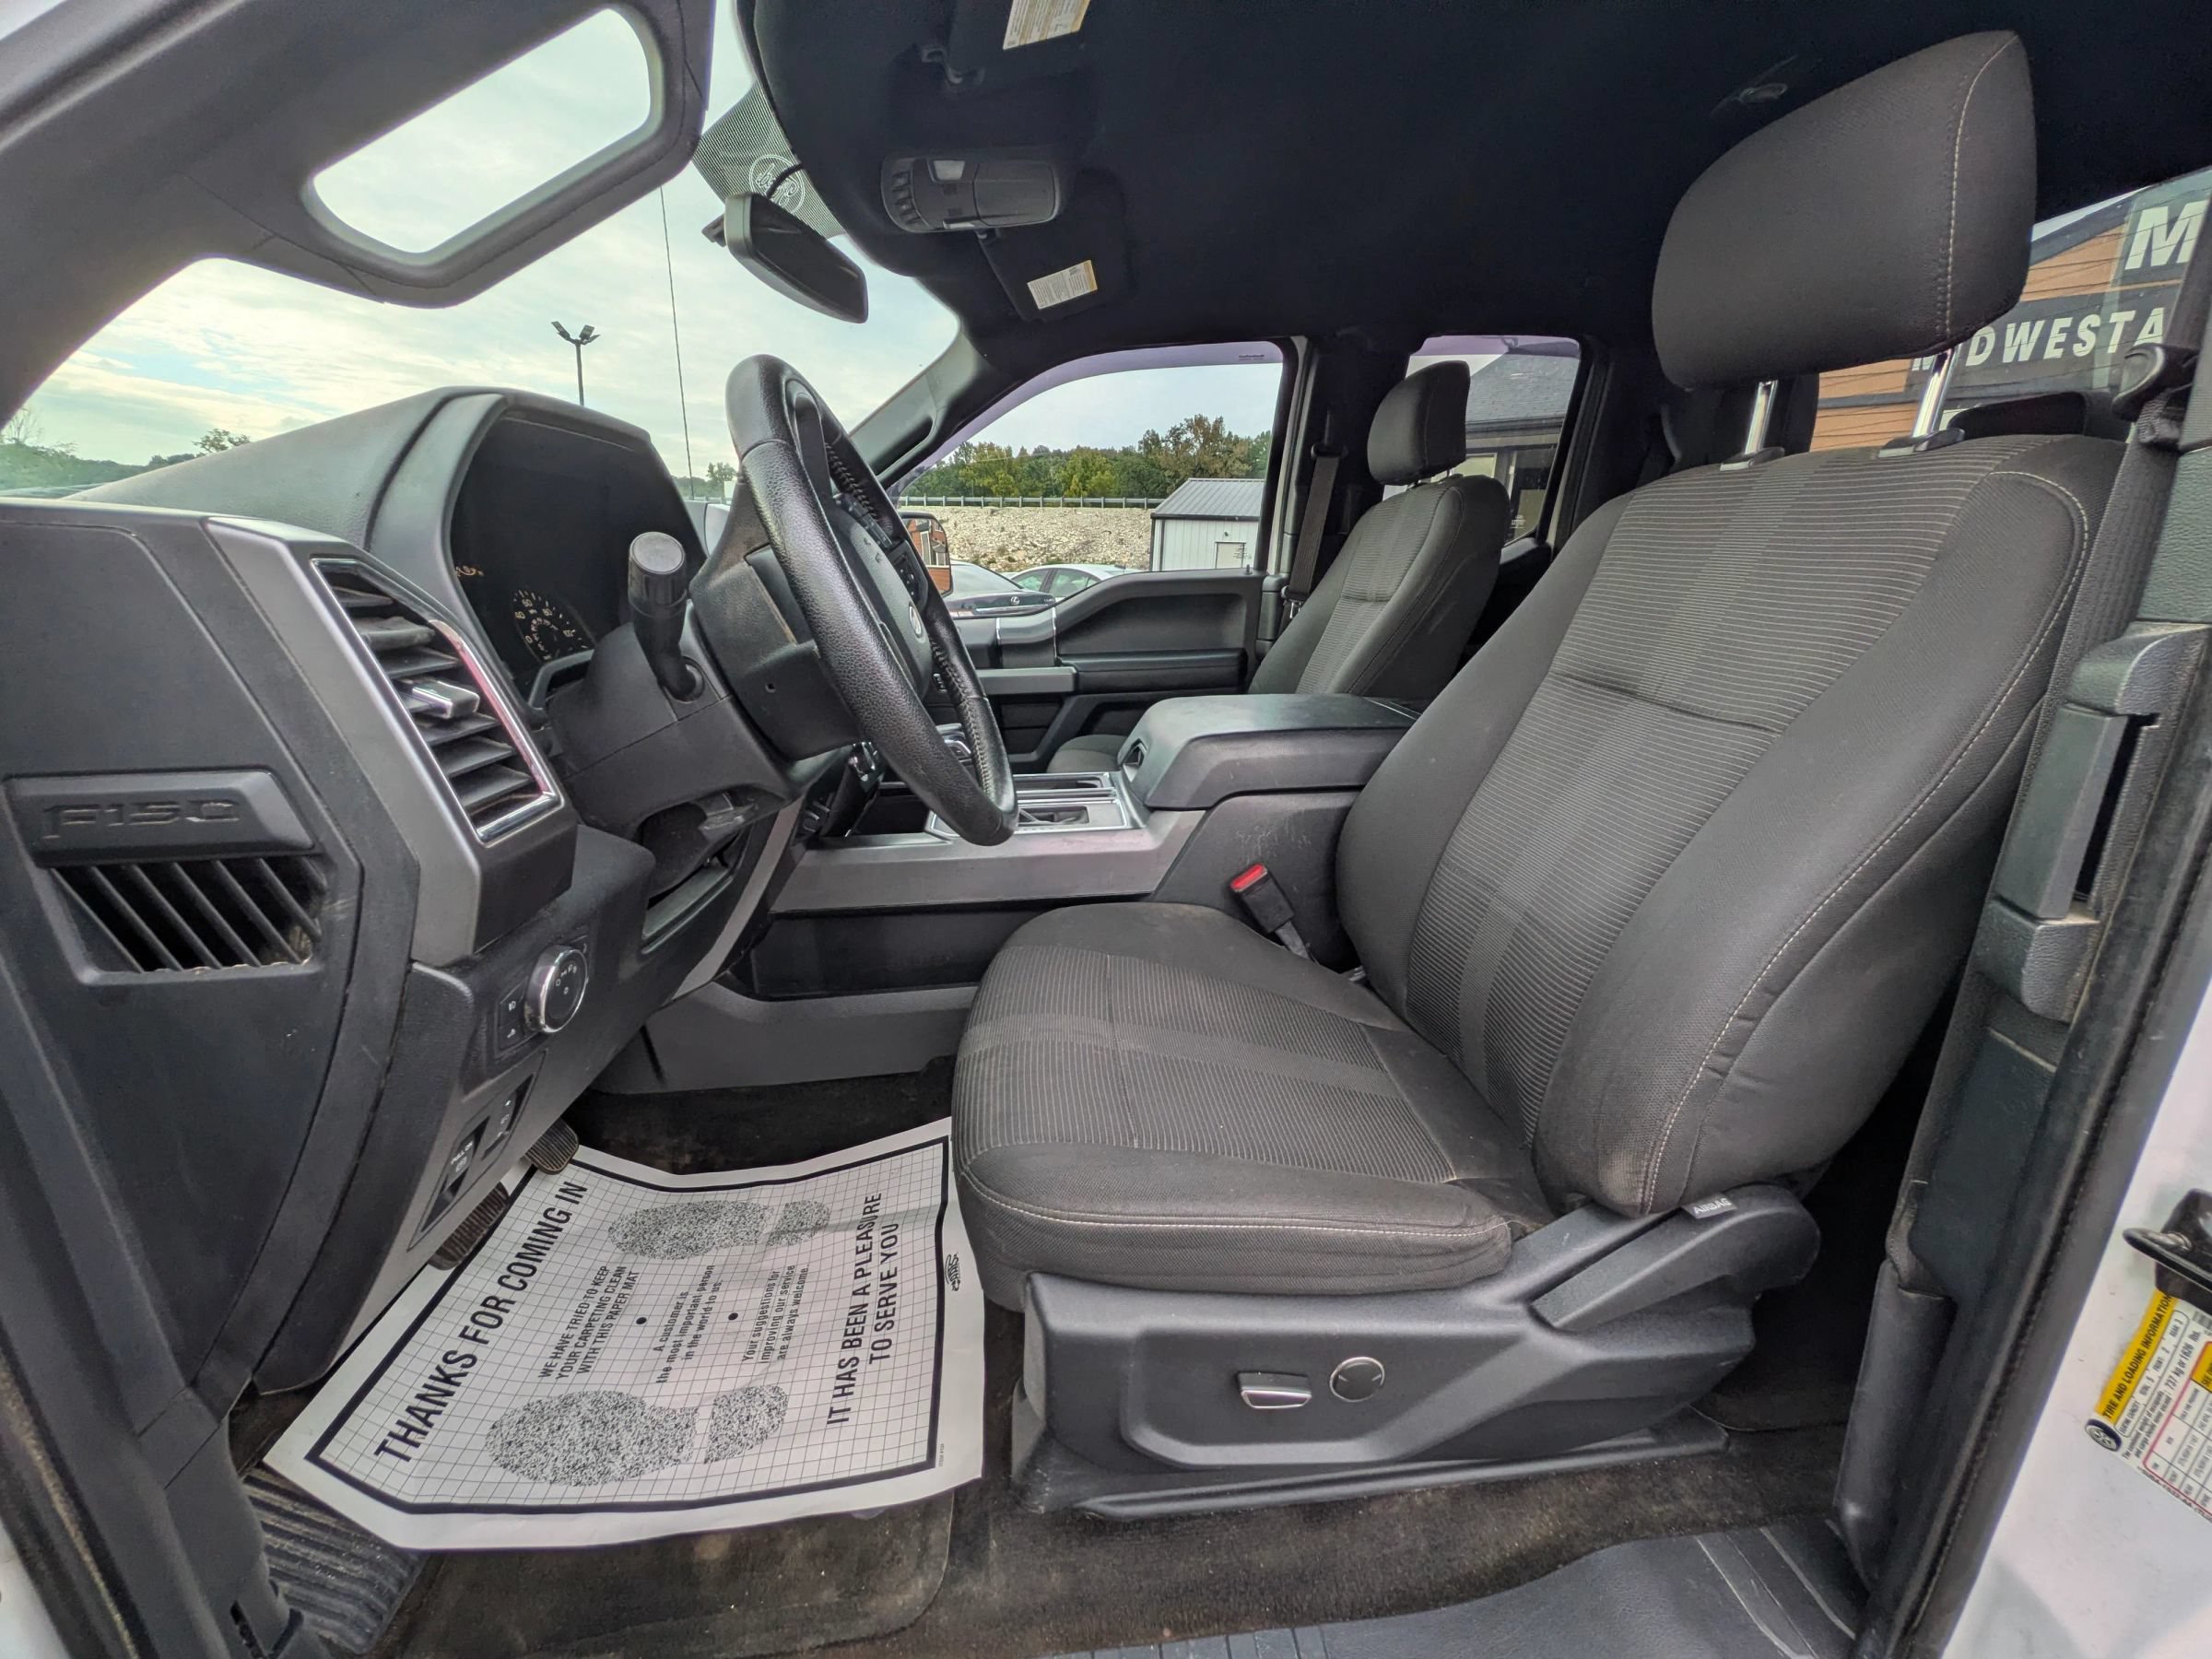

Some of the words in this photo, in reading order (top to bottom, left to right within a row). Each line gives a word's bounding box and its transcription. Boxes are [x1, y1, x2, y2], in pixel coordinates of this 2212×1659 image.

[1692, 1197, 1732, 1214] AIRBAG
[853, 1192, 882, 1280] PLEASURE
[880, 1222, 900, 1265] YOU
[705, 1295, 717, 1305] to
[780, 1265, 795, 1295] service
[852, 1283, 871, 1297] A
[873, 1266, 898, 1333] SERVE
[373, 1349, 477, 1463] THANKS
[458, 1295, 516, 1345] FOR
[498, 1207, 572, 1291] COMING
[555, 1181, 588, 1206] IN
[538, 1361, 558, 1378] WE
[549, 1334, 573, 1359] HAVE
[566, 1302, 590, 1331] TRIED
[582, 1288, 598, 1300] TO
[591, 1265, 610, 1287] KEEP
[556, 1350, 582, 1380] YOUR
[574, 1296, 611, 1348] CARPETING
[605, 1266, 627, 1294] CLEAN
[576, 1347, 601, 1374] WITH
[593, 1323, 613, 1346] THIS
[606, 1292, 630, 1320] PAPER
[622, 1271, 640, 1290] MAT
[655, 1366, 672, 1383] the
[666, 1339, 684, 1363] most
[675, 1295, 702, 1336] important
[697, 1265, 715, 1291] person
[659, 1301, 684, 1342] customer
[696, 1307, 713, 1332] world
[742, 1340, 758, 1361] Your
[752, 1282, 776, 1337] suggestions
[768, 1271, 780, 1282] for
[775, 1298, 786, 1312] our
[782, 1309, 799, 1341] always
[687, 1334, 701, 1347] the
[758, 1315, 783, 1364] improving
[841, 1302, 869, 1350] BEEN
[681, 1351, 695, 1360] in
[777, 1344, 789, 1360] are
[868, 1337, 893, 1365] TO
[832, 1355, 860, 1399] HAS
[2102, 1399, 2118, 1419] TIRE
[2113, 1382, 2127, 1401] AND
[2123, 1348, 2146, 1384] LOADING
[2164, 1374, 2177, 1390] 737
[2171, 1366, 2185, 1377] kg
[827, 1406, 852, 1425] IT
